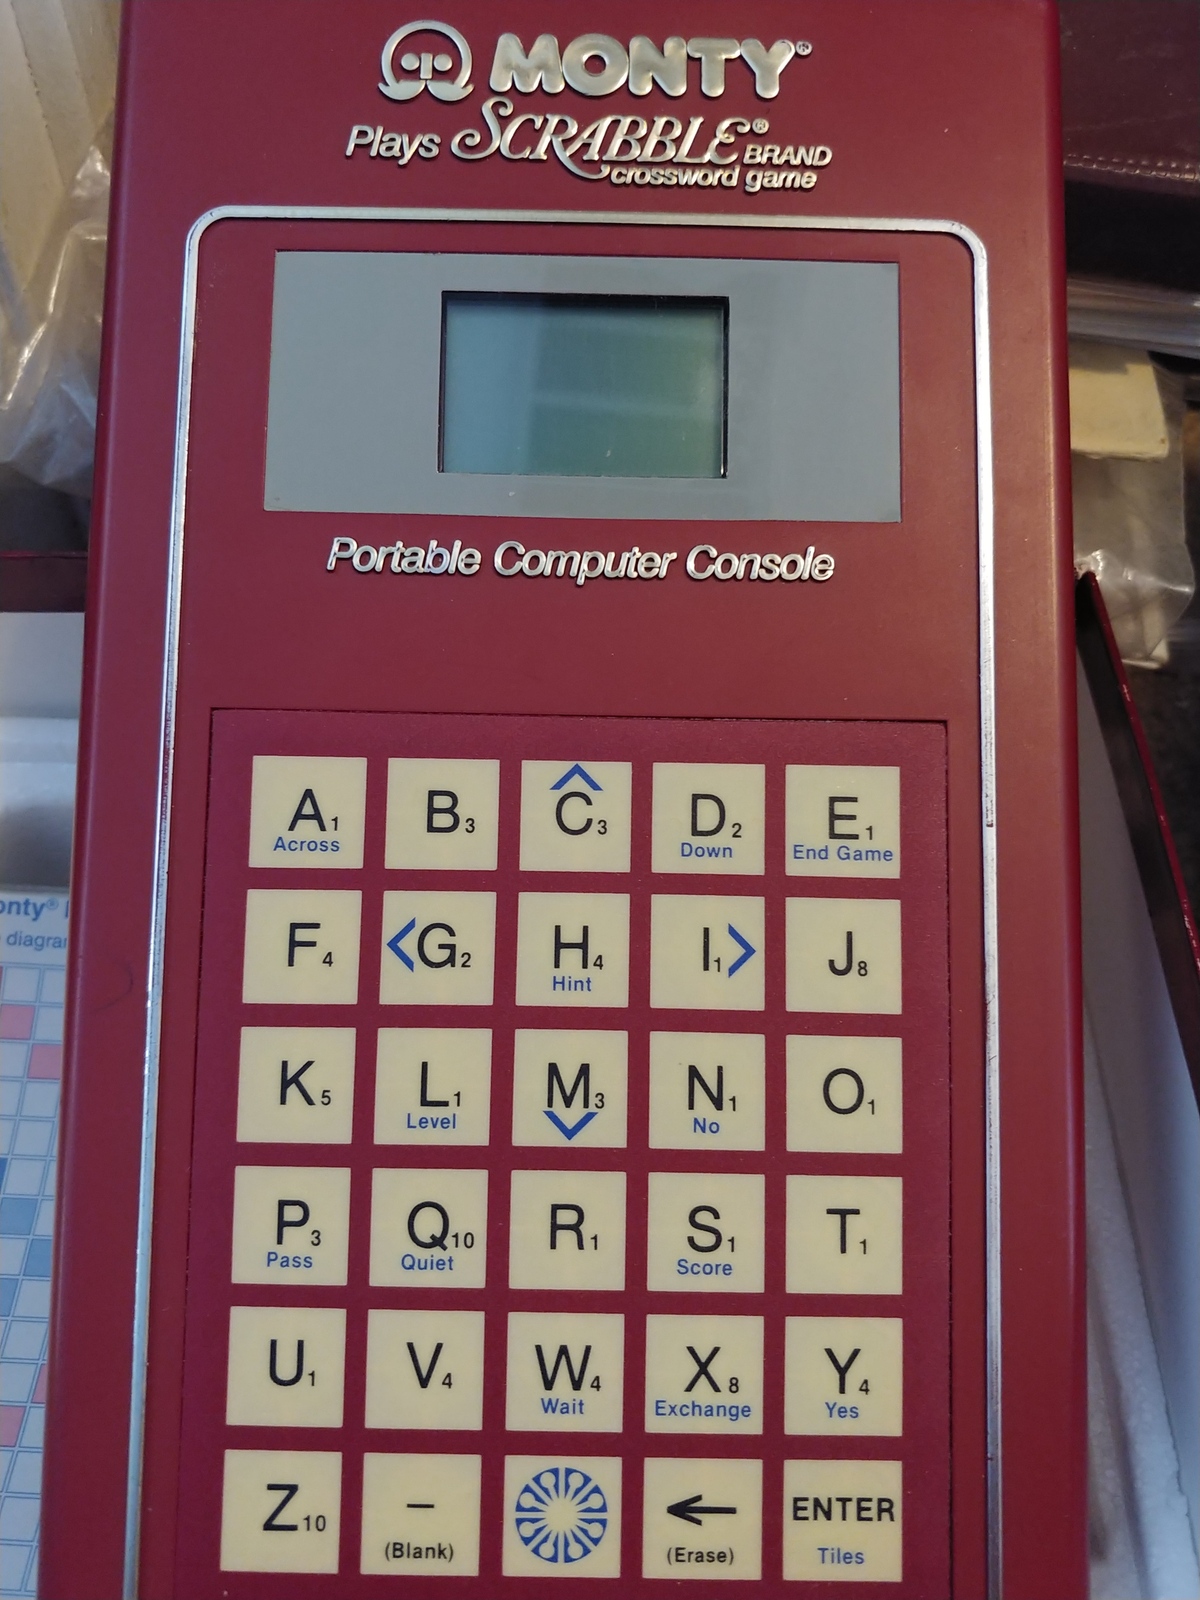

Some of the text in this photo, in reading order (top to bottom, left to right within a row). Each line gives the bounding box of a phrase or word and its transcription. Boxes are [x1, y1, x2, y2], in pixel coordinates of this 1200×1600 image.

[344, 124, 441, 166] Plays
[742, 145, 832, 167] BRAND
[609, 166, 818, 193] crossword game
[326, 536, 836, 586] Portable Computer Console
[273, 836, 340, 852] Across
[680, 842, 733, 858] Down
[793, 844, 894, 862] End Game
[6, 930, 68, 952] diagra
[552, 975, 592, 992] Hint
[407, 1112, 457, 1130] Level
[693, 1117, 720, 1134] No
[266, 1251, 313, 1269] Pass
[401, 1253, 454, 1271] Quiet
[676, 1258, 733, 1276] Score
[540, 1397, 585, 1415] Wait
[655, 1399, 751, 1422] Exchange
[825, 1402, 859, 1419] Yes
[792, 1496, 895, 1522] ENTER
[384, 1541, 454, 1563] (Blank)
[666, 1546, 735, 1565] (Erase)
[817, 1547, 864, 1565] Tiles
